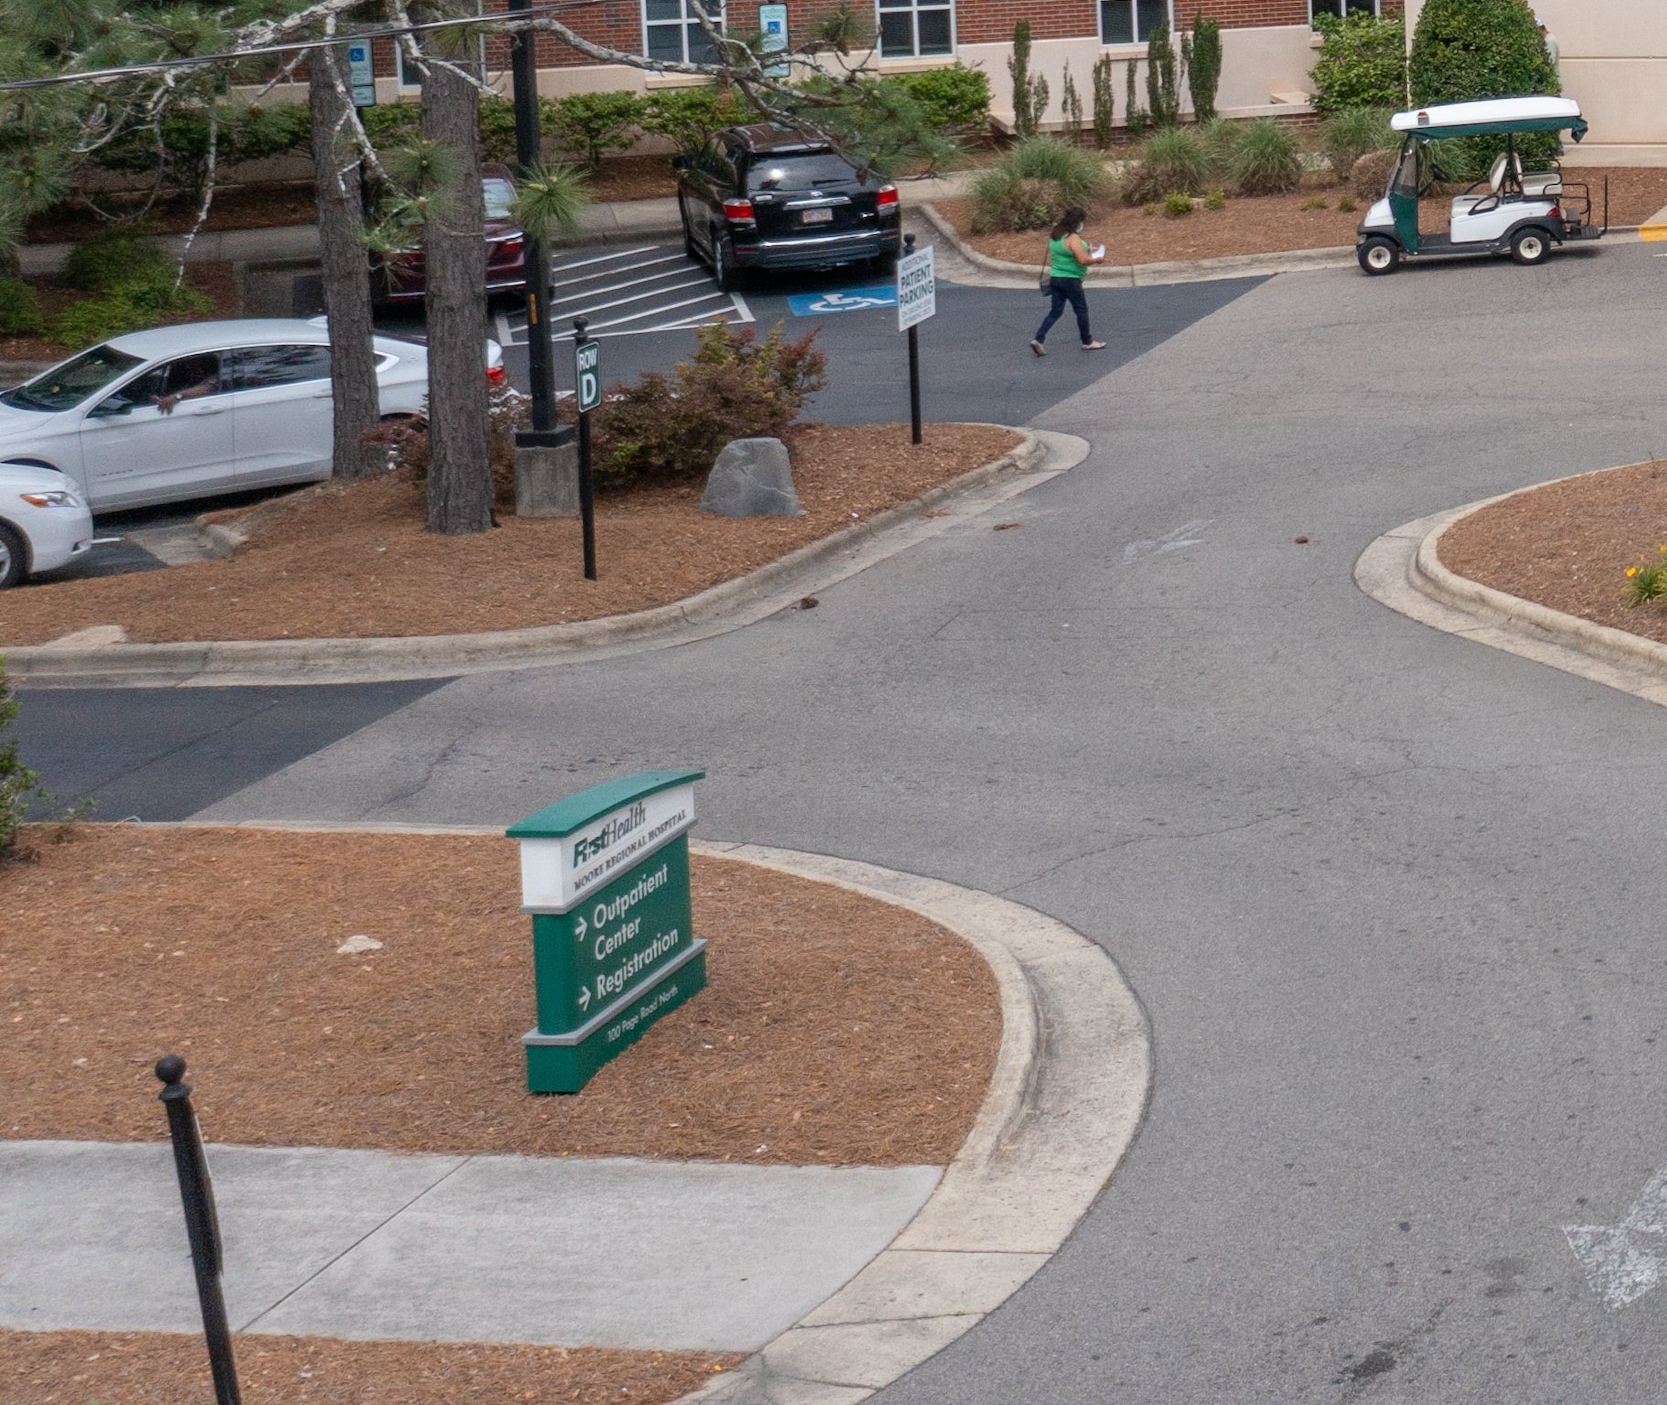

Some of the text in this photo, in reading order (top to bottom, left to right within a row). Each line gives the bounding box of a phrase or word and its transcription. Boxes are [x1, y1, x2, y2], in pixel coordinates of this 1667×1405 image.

[900, 280, 934, 309] PARKING
[901, 264, 931, 290] PATIENT
[579, 348, 598, 371] ROW
[582, 373, 596, 405] D
[574, 809, 687, 891] MOORE REGIONAL HOSPITAL
[593, 863, 668, 929] Outpatient
[595, 917, 641, 960] Center
[596, 928, 678, 1000] Registration
[607, 985, 678, 1042] 100 Page Road North
